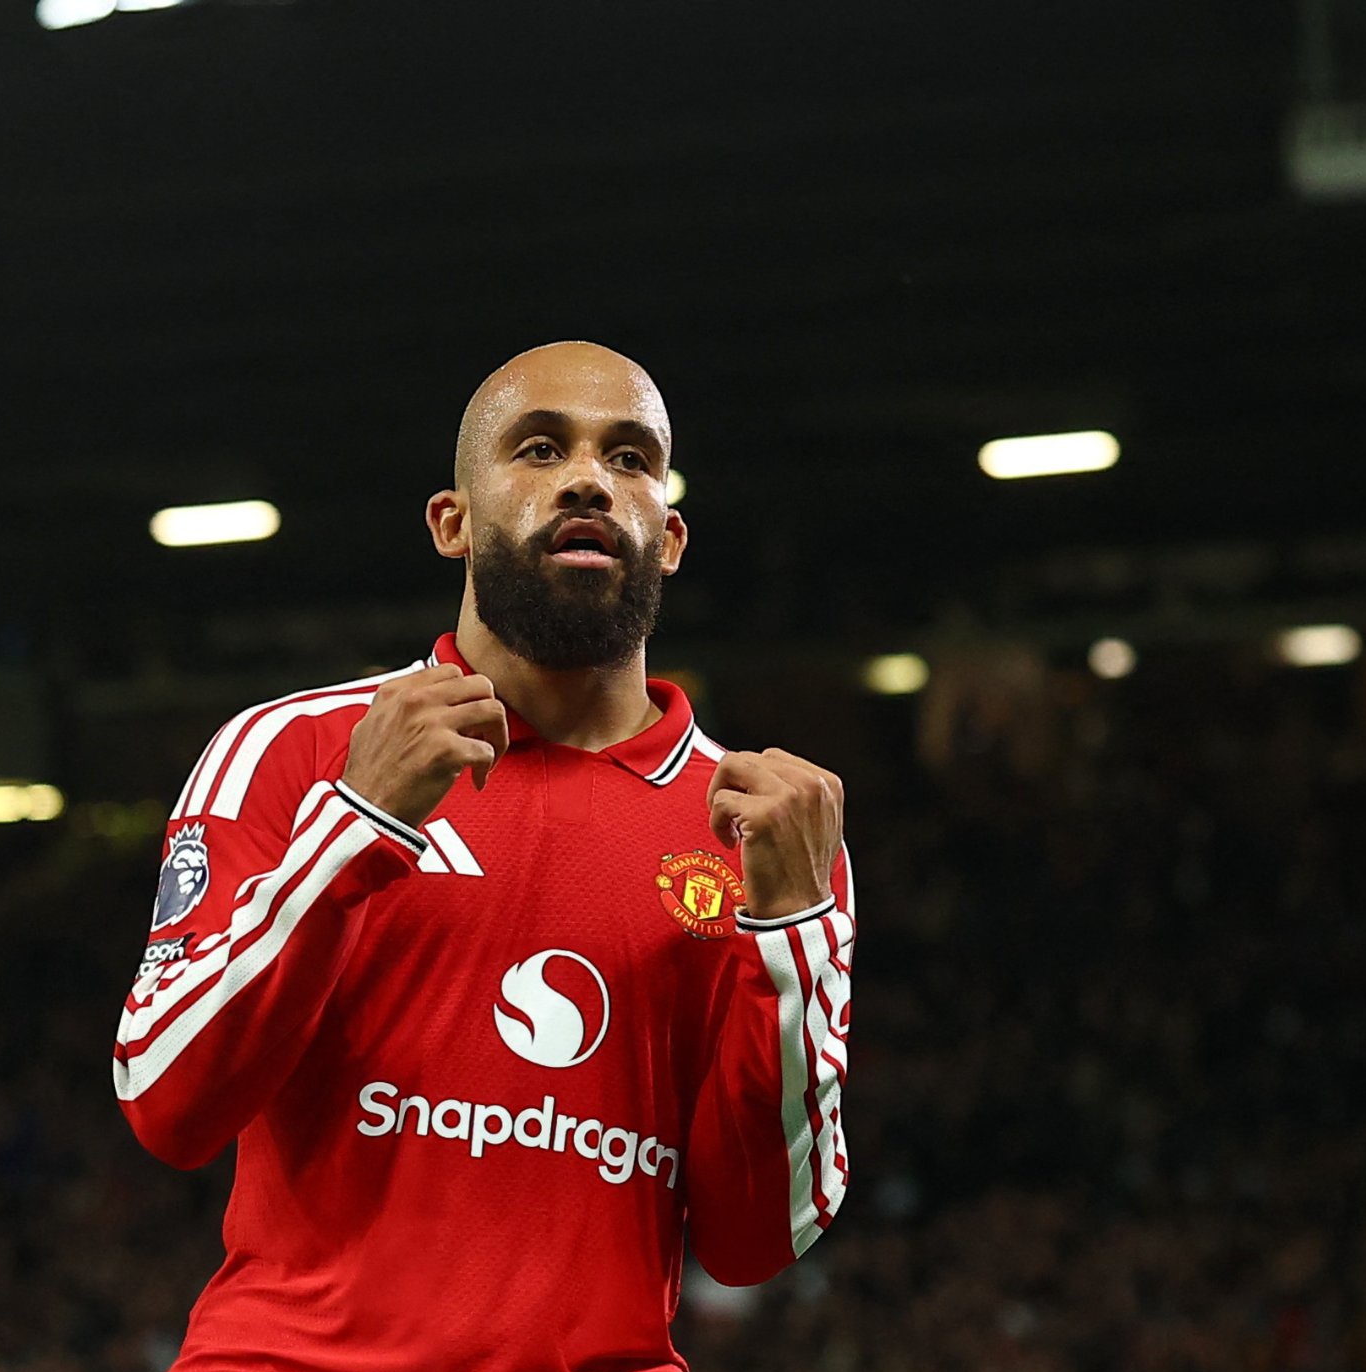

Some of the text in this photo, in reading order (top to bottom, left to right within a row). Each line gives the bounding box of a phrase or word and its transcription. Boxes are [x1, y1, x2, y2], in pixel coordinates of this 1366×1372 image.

[669, 856, 743, 898] MANCHESTER
[673, 906, 724, 934] UNITED
[356, 1081, 680, 1189] Snapdragon
